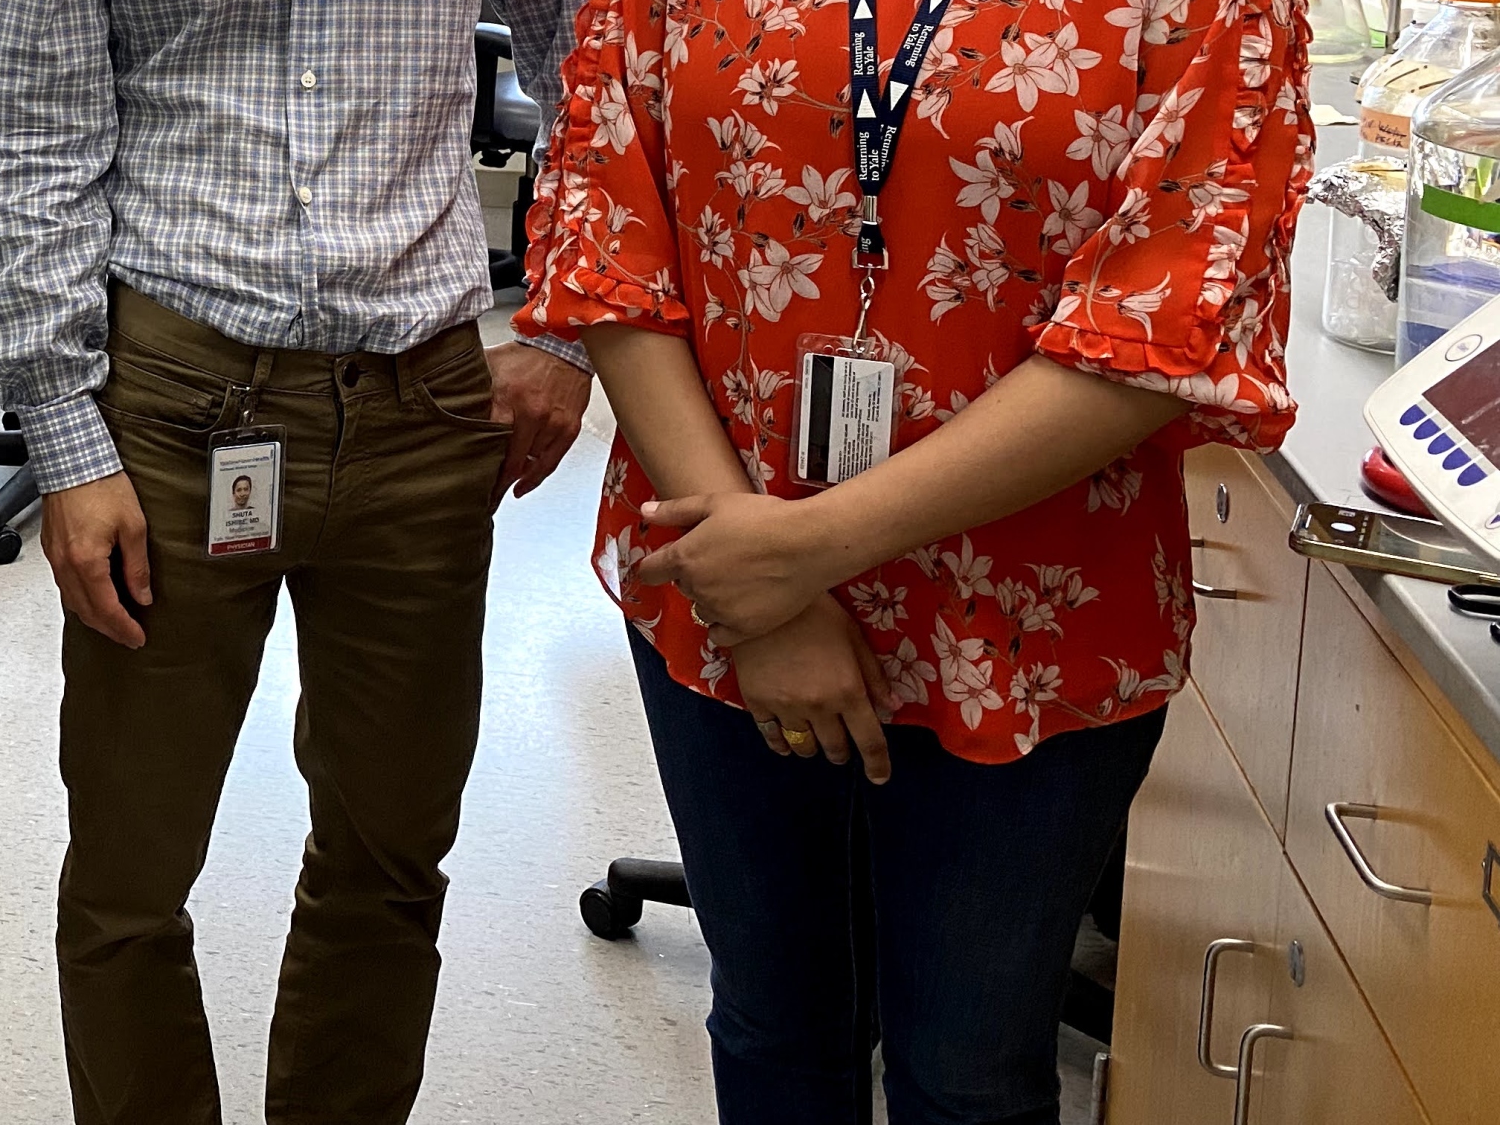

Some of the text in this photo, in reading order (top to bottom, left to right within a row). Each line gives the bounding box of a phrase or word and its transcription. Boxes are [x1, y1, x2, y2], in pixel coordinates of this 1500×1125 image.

[903, 23, 921, 50] to Yale
[904, 24, 934, 68] Returning
[852, 32, 865, 76] Returning
[864, 45, 874, 75] to Yale
[857, 131, 869, 181] Returning
[868, 148, 879, 181] to Yale
[232, 511, 253, 519] SHUTA
